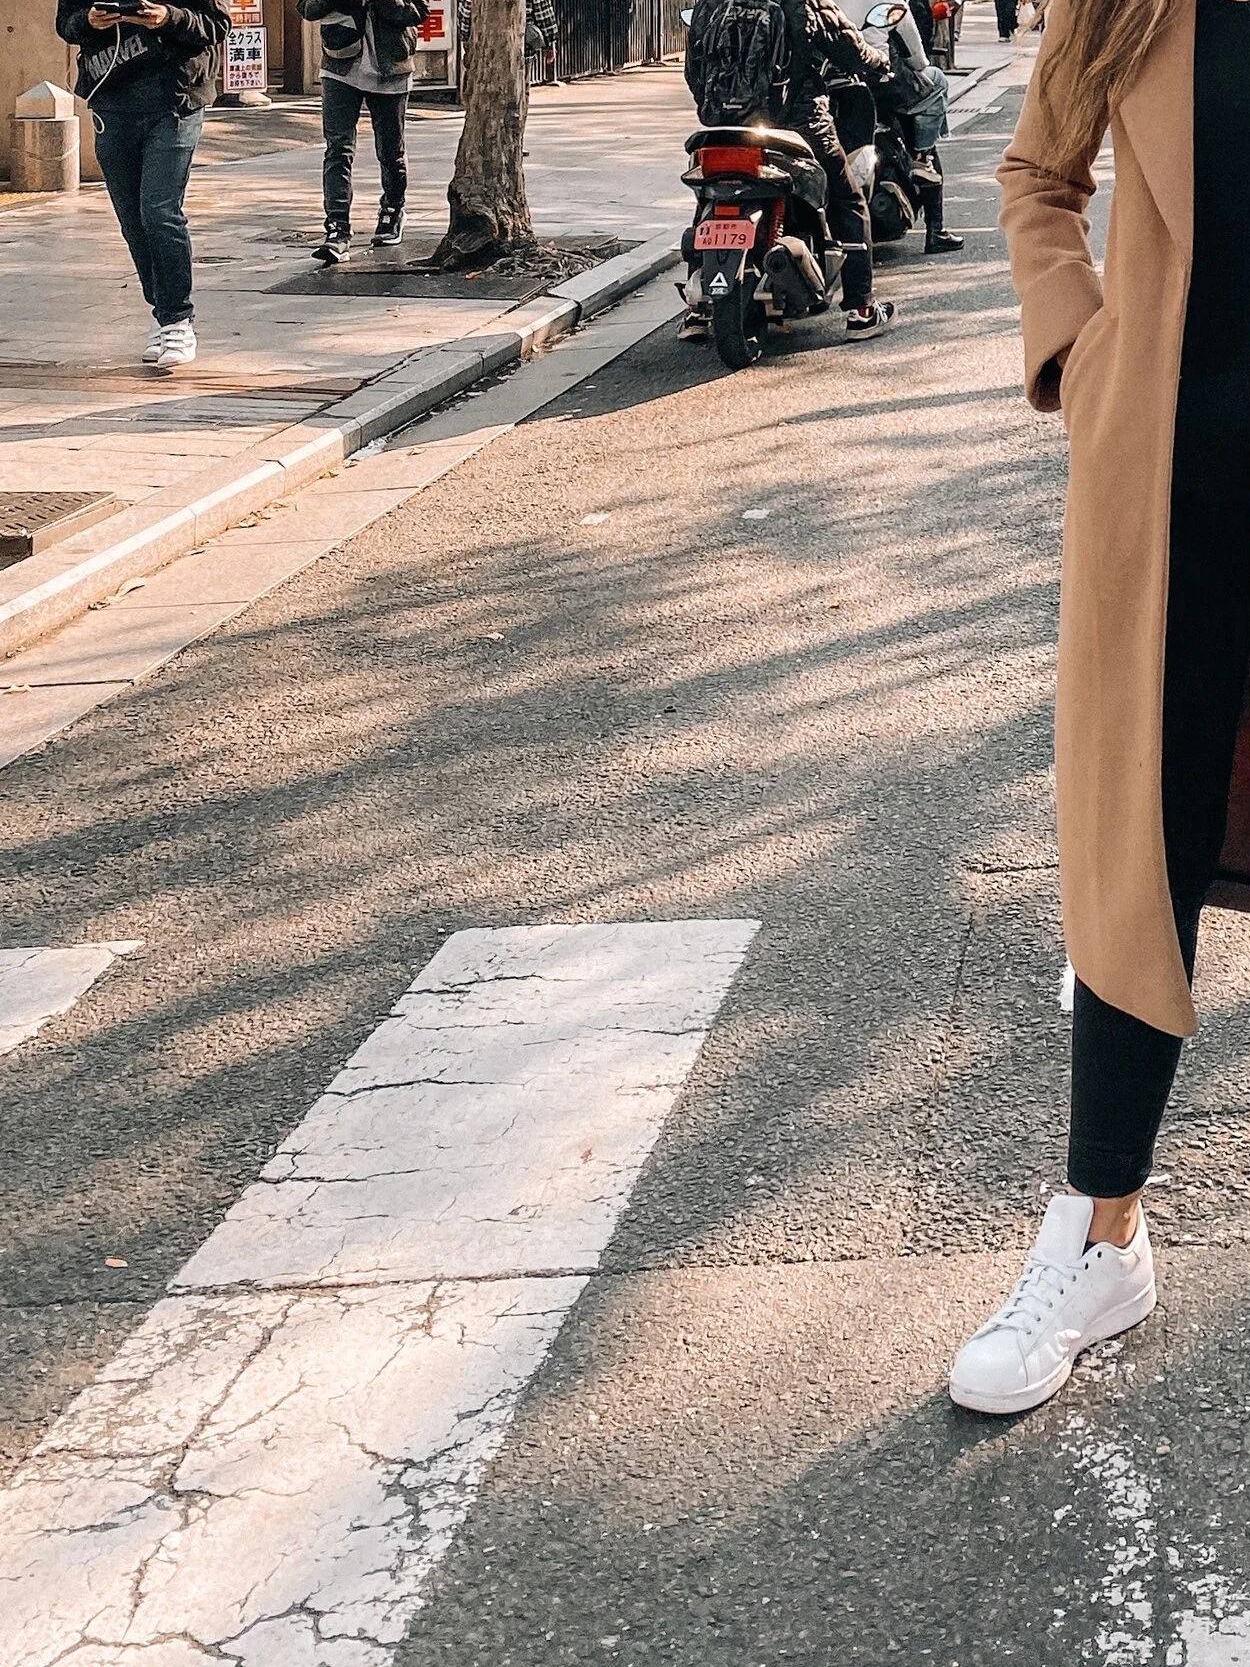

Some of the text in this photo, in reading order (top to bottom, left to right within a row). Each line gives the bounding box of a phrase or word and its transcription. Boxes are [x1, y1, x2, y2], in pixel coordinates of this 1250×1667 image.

[229, 31, 262, 45] 全クラス
[84, 34, 149, 81] MARVEL
[229, 47, 262, 62] 満車
[714, 233, 747, 245] 1179
